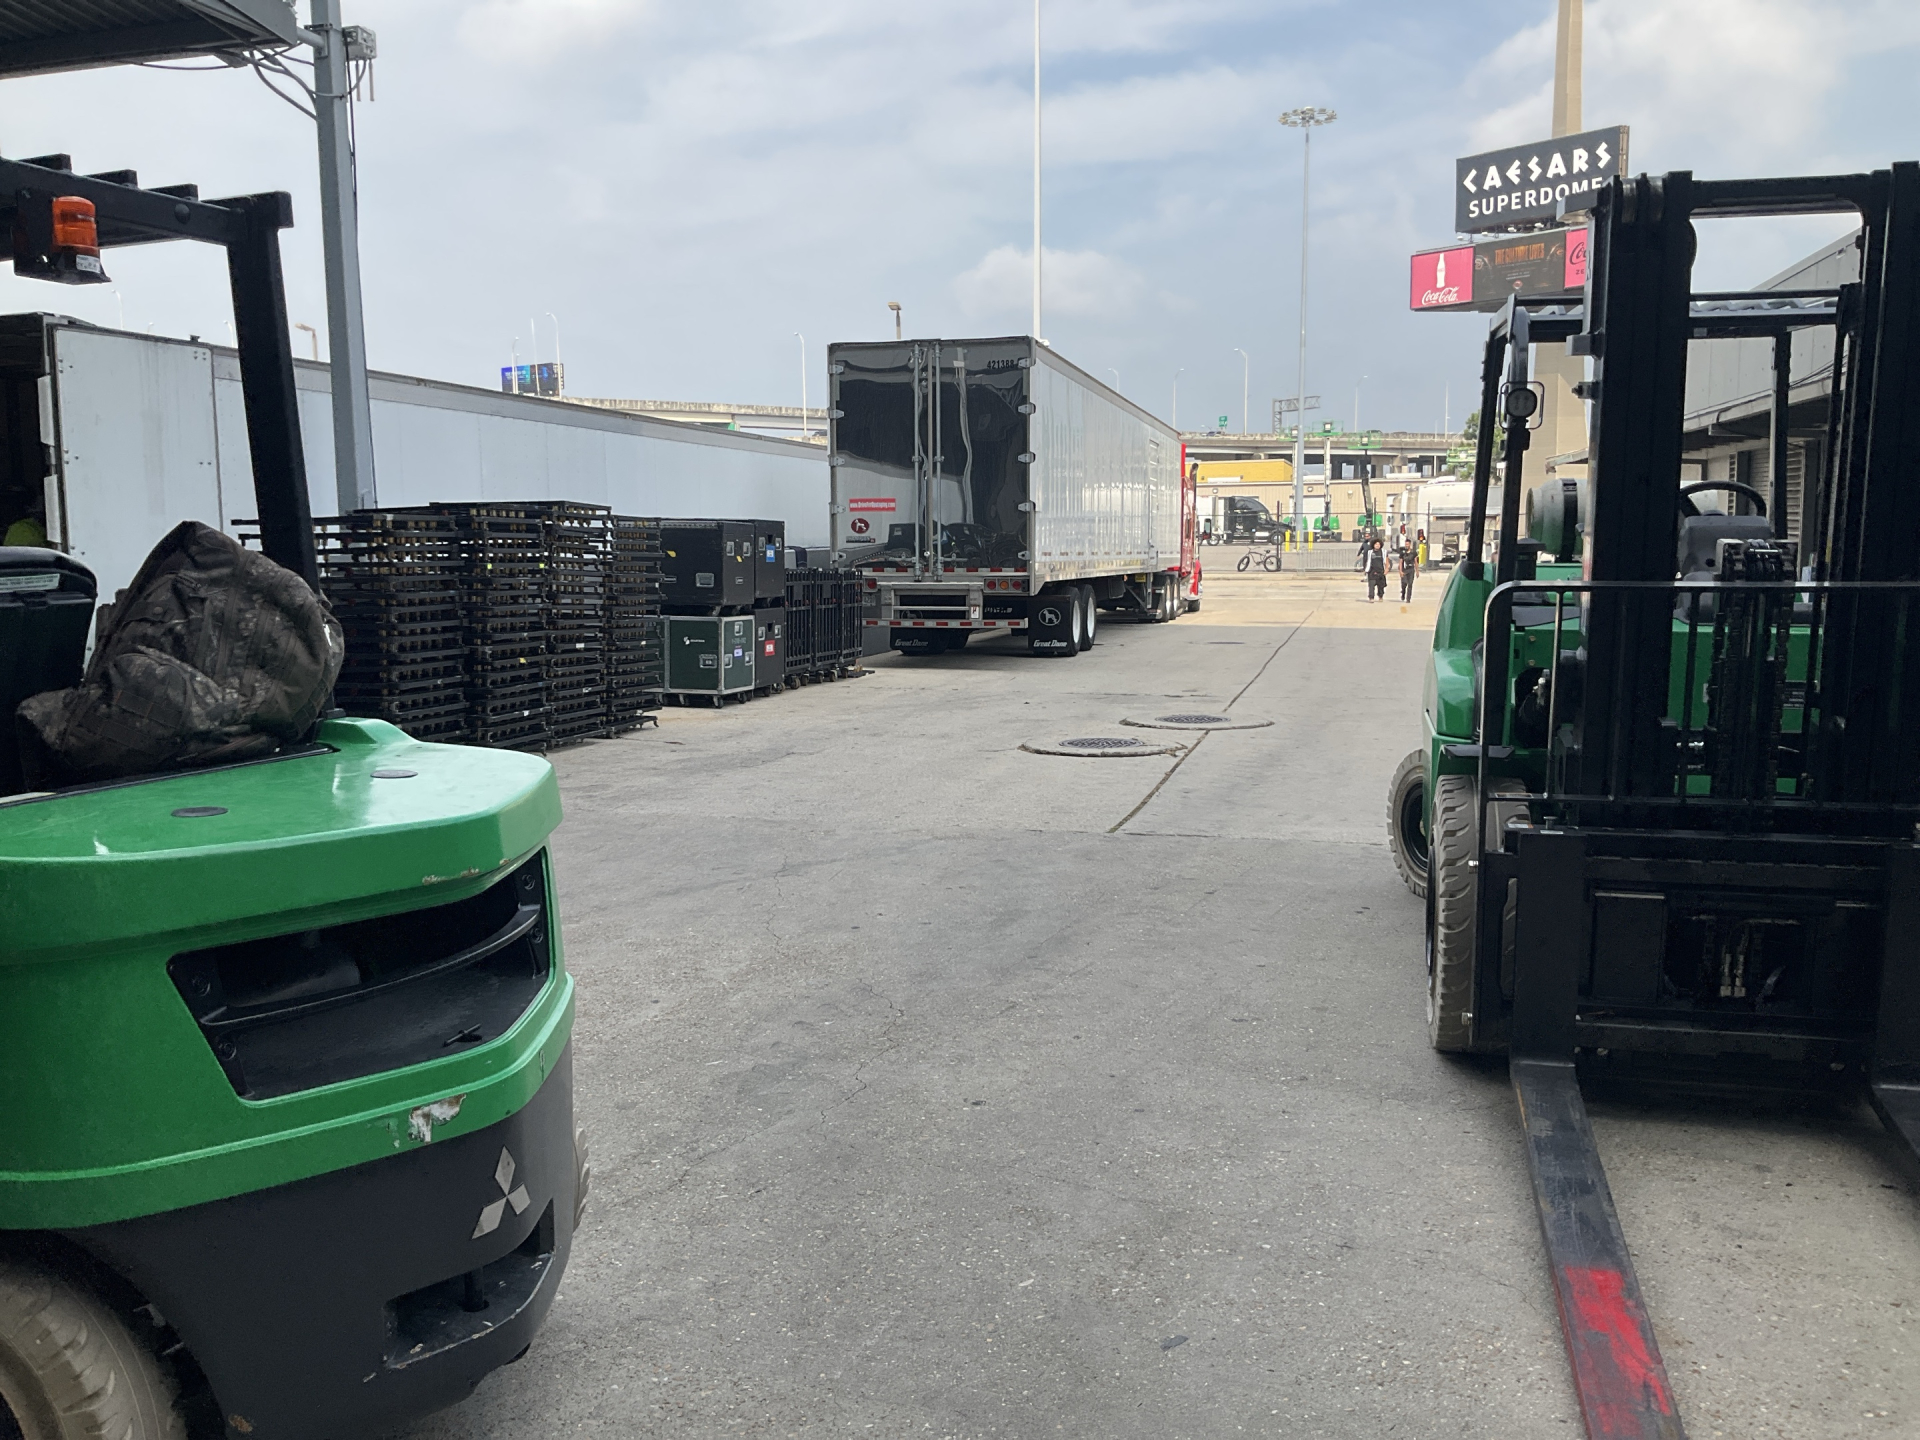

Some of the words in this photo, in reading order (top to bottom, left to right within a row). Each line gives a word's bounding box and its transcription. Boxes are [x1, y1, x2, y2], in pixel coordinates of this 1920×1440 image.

[1463, 142, 1611, 193] CAESARS
[1468, 177, 1603, 218] SUPERDOME
[1421, 286, 1459, 306] Coca-Cola
[1033, 639, 1052, 648] Great
[1051, 639, 1068, 648] Dane
